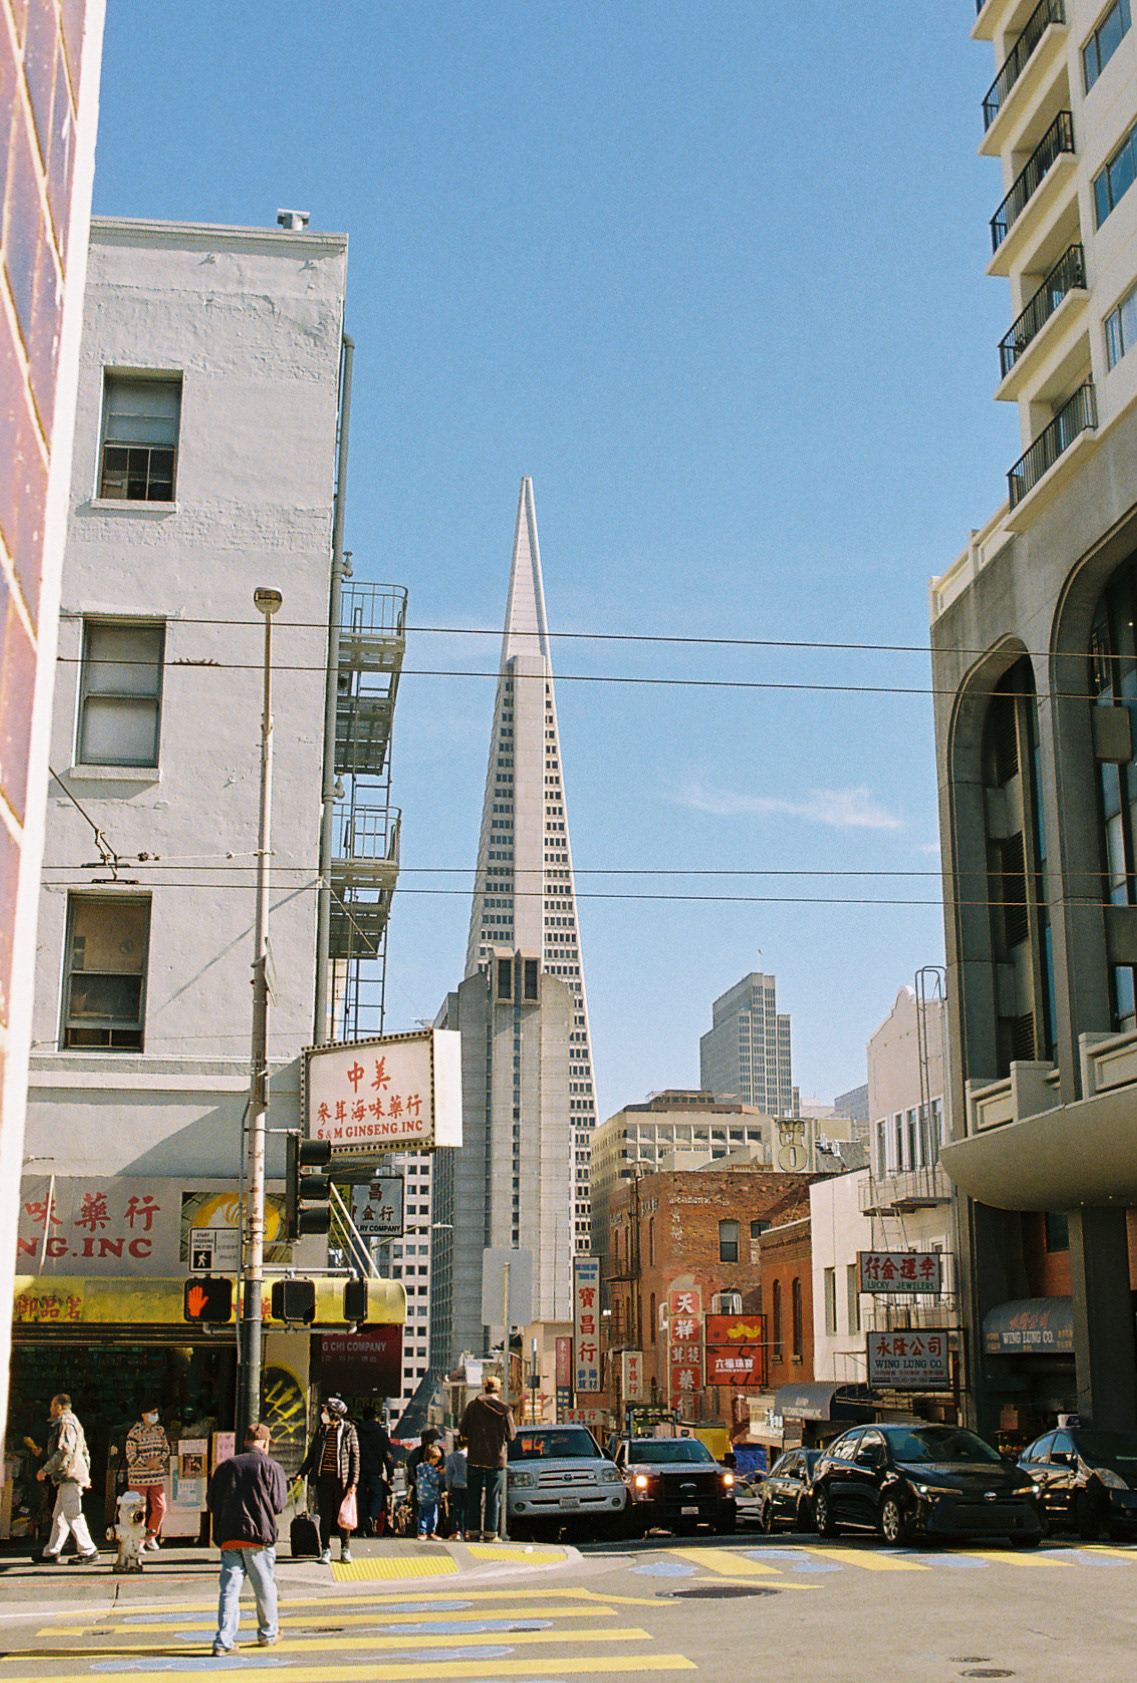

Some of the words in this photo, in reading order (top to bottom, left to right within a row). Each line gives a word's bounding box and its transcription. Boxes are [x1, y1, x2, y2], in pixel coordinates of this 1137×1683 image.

[347, 1056, 391, 1094] 中美
[867, 1281, 890, 1290] LUCKY
[578, 1287, 598, 1363] 寶昌行
[346, 1341, 387, 1352] COMPANY
[876, 1336, 942, 1357] 永隆公司
[875, 1360, 900, 1369] WING
[903, 1360, 927, 1369] LUNG
